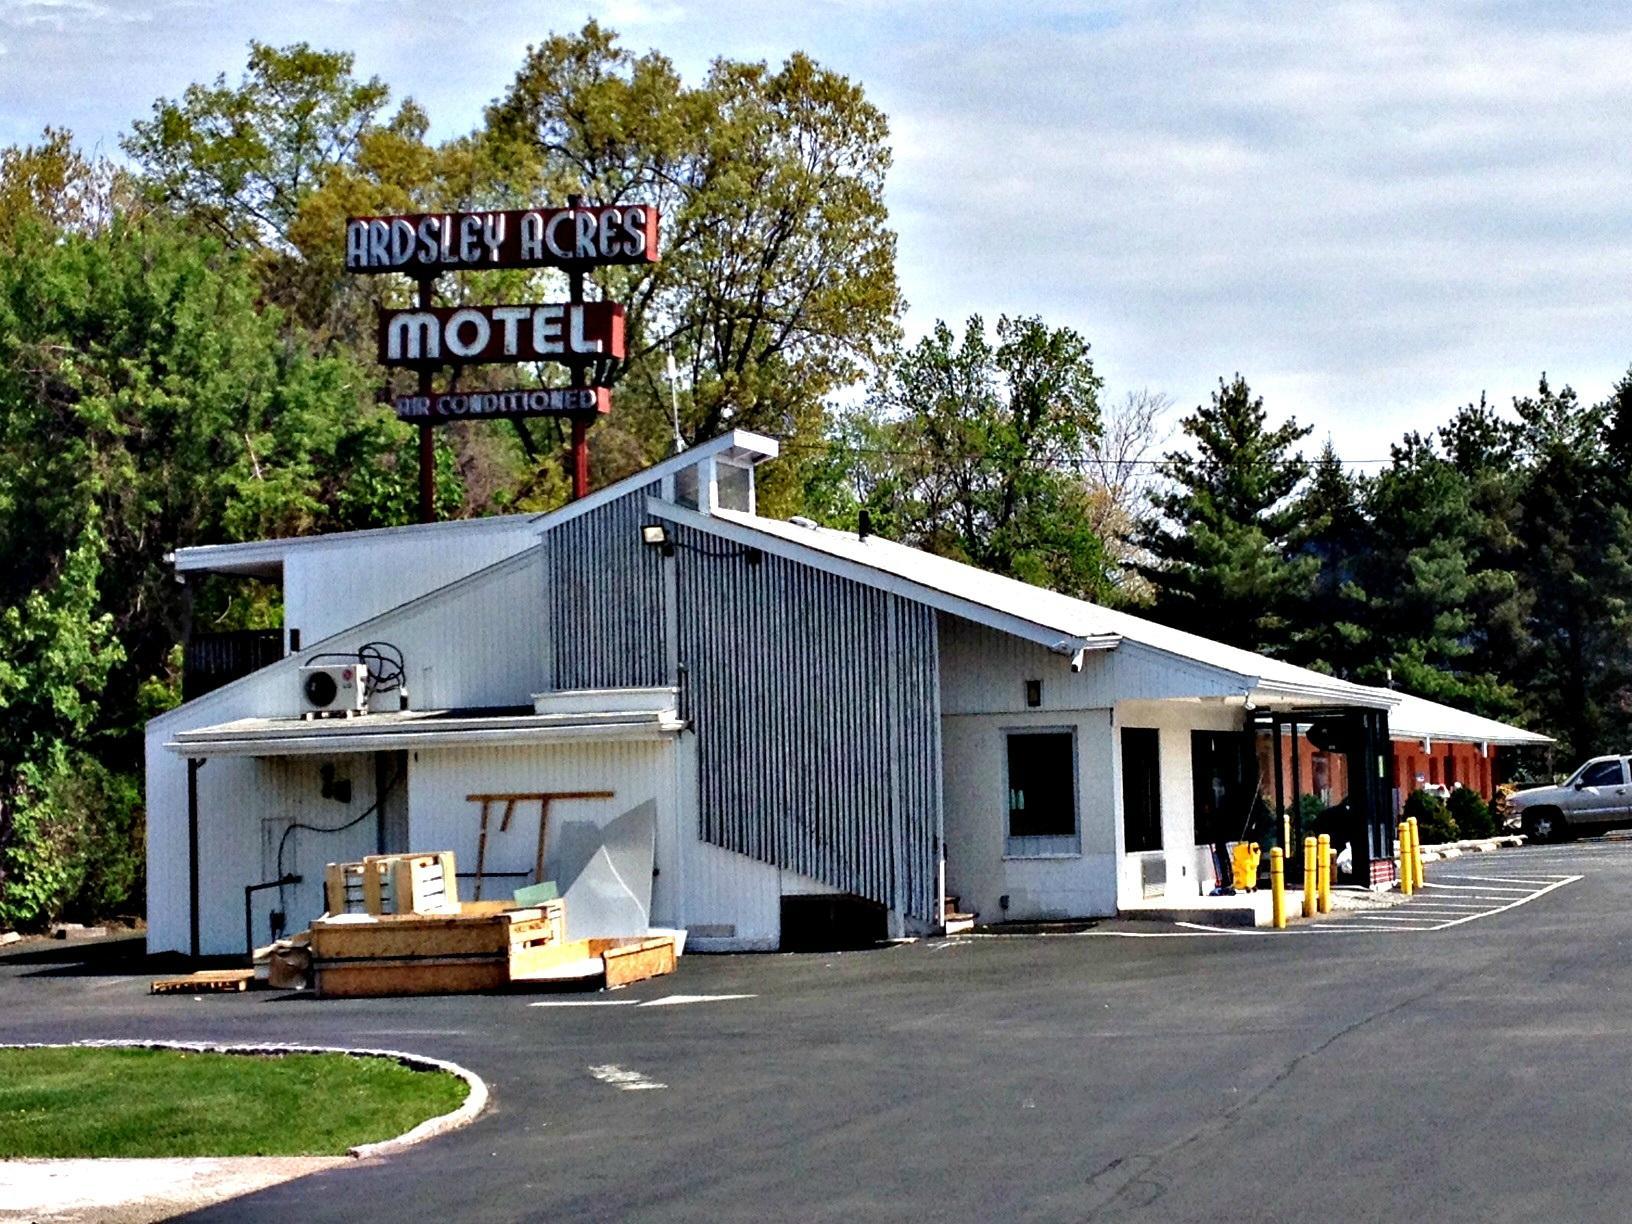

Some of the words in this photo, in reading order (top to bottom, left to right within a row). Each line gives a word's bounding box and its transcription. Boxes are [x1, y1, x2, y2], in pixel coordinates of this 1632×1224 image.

[347, 213, 505, 267] ARDSLEY
[520, 207, 646, 260] ACRES
[388, 305, 602, 359] MOTEL
[396, 396, 430, 416] AIR
[436, 389, 596, 415] CONDITIONED
